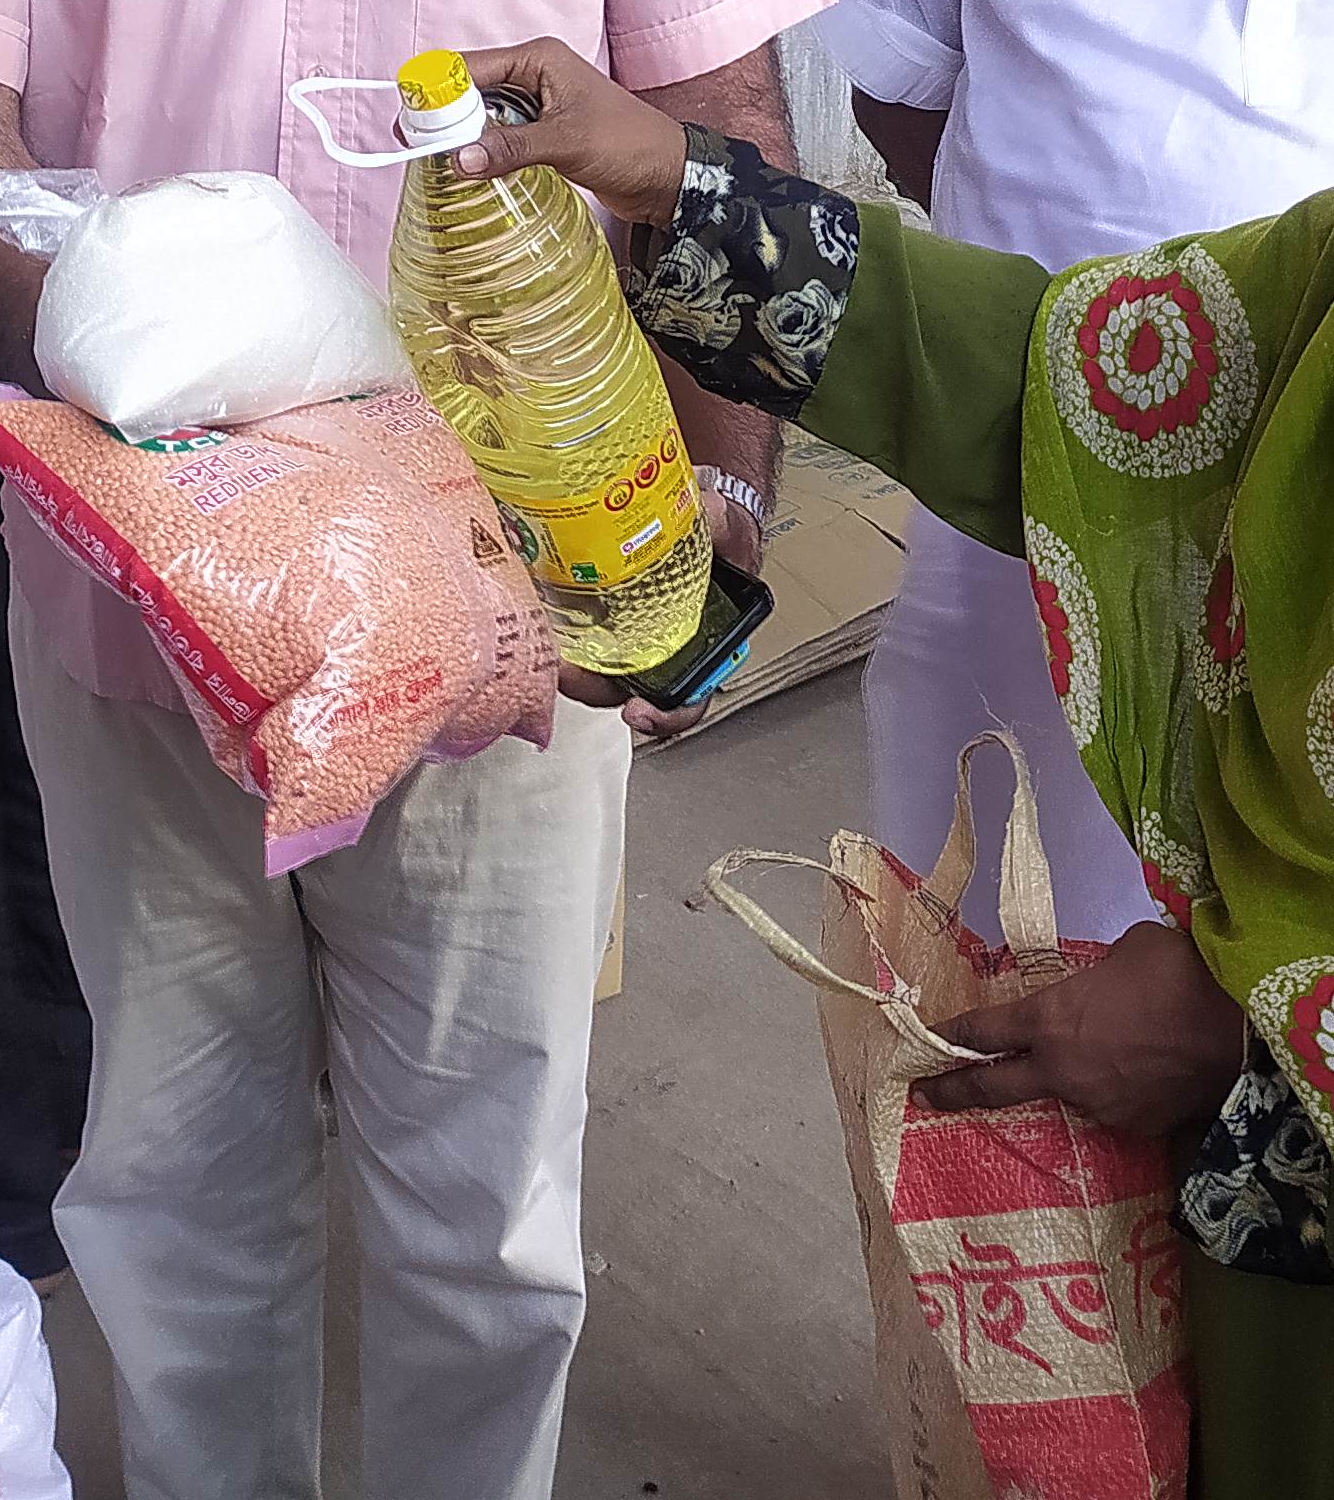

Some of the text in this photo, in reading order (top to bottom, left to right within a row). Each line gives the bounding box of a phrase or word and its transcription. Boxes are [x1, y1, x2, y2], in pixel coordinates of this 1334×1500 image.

[385, 413, 419, 437] RED
[167, 452, 232, 491] মসুর
[193, 484, 240, 515] RED
